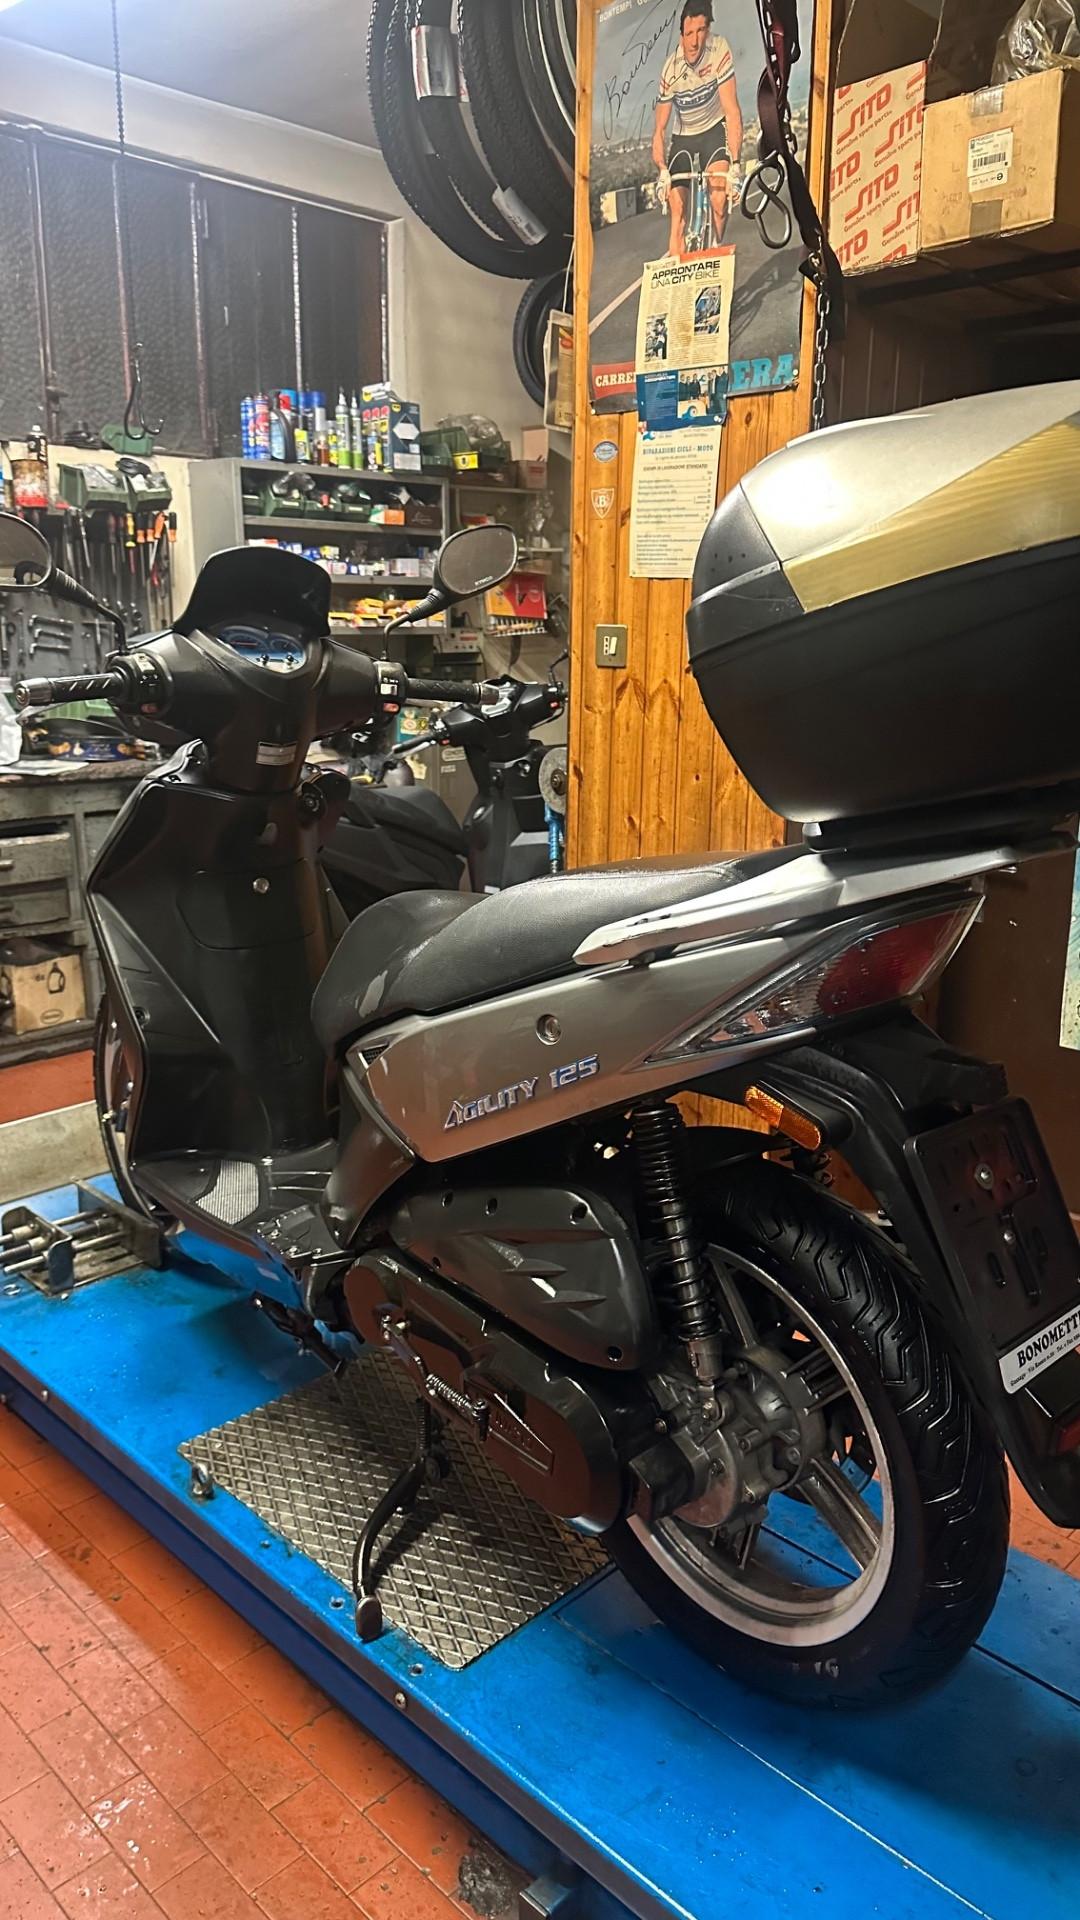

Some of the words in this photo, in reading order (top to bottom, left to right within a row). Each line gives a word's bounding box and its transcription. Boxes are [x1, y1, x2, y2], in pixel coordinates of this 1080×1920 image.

[651, 278, 670, 289] UNA
[671, 273, 694, 284] CITY
[695, 269, 719, 280] BIKE
[652, 260, 720, 281] APPRONTARE
[595, 371, 636, 387] CARRE
[444, 1076, 539, 1129] AGILITY
[549, 1054, 599, 1089] 125
